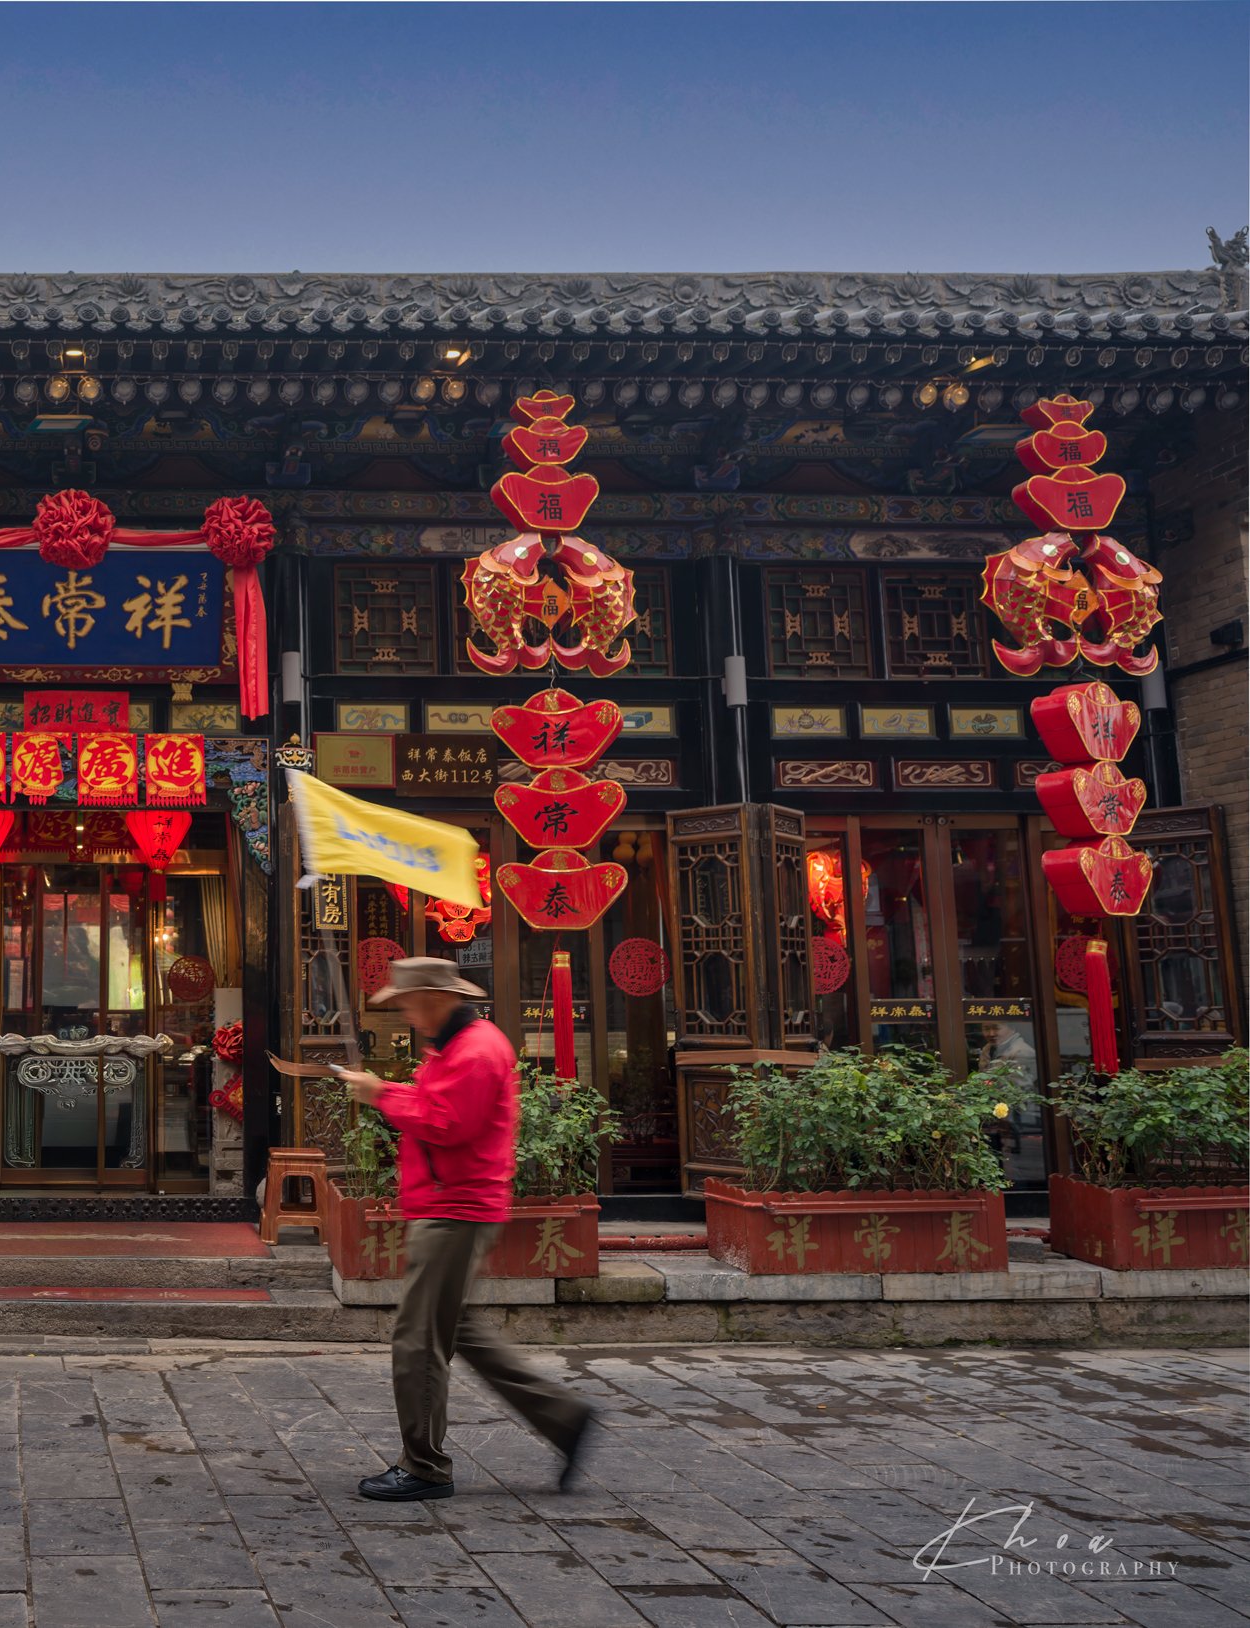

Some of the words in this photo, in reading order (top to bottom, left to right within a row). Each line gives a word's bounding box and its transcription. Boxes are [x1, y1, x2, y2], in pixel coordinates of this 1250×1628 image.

[536, 438, 561, 458] 福
[1058, 442, 1082, 462] 福
[536, 492, 562, 521] 福
[1067, 490, 1094, 519] 福
[29, 701, 123, 728] 招財進寶
[530, 720, 577, 756] 祥
[407, 747, 489, 764] 祥常泰饭店
[401, 768, 495, 784] 西大街112号
[534, 801, 579, 839] 常
[1097, 791, 1123, 824] 常
[536, 880, 582, 919] 泰
[1109, 869, 1131, 904] 泰
[766, 1212, 993, 1270] 祥常泰
